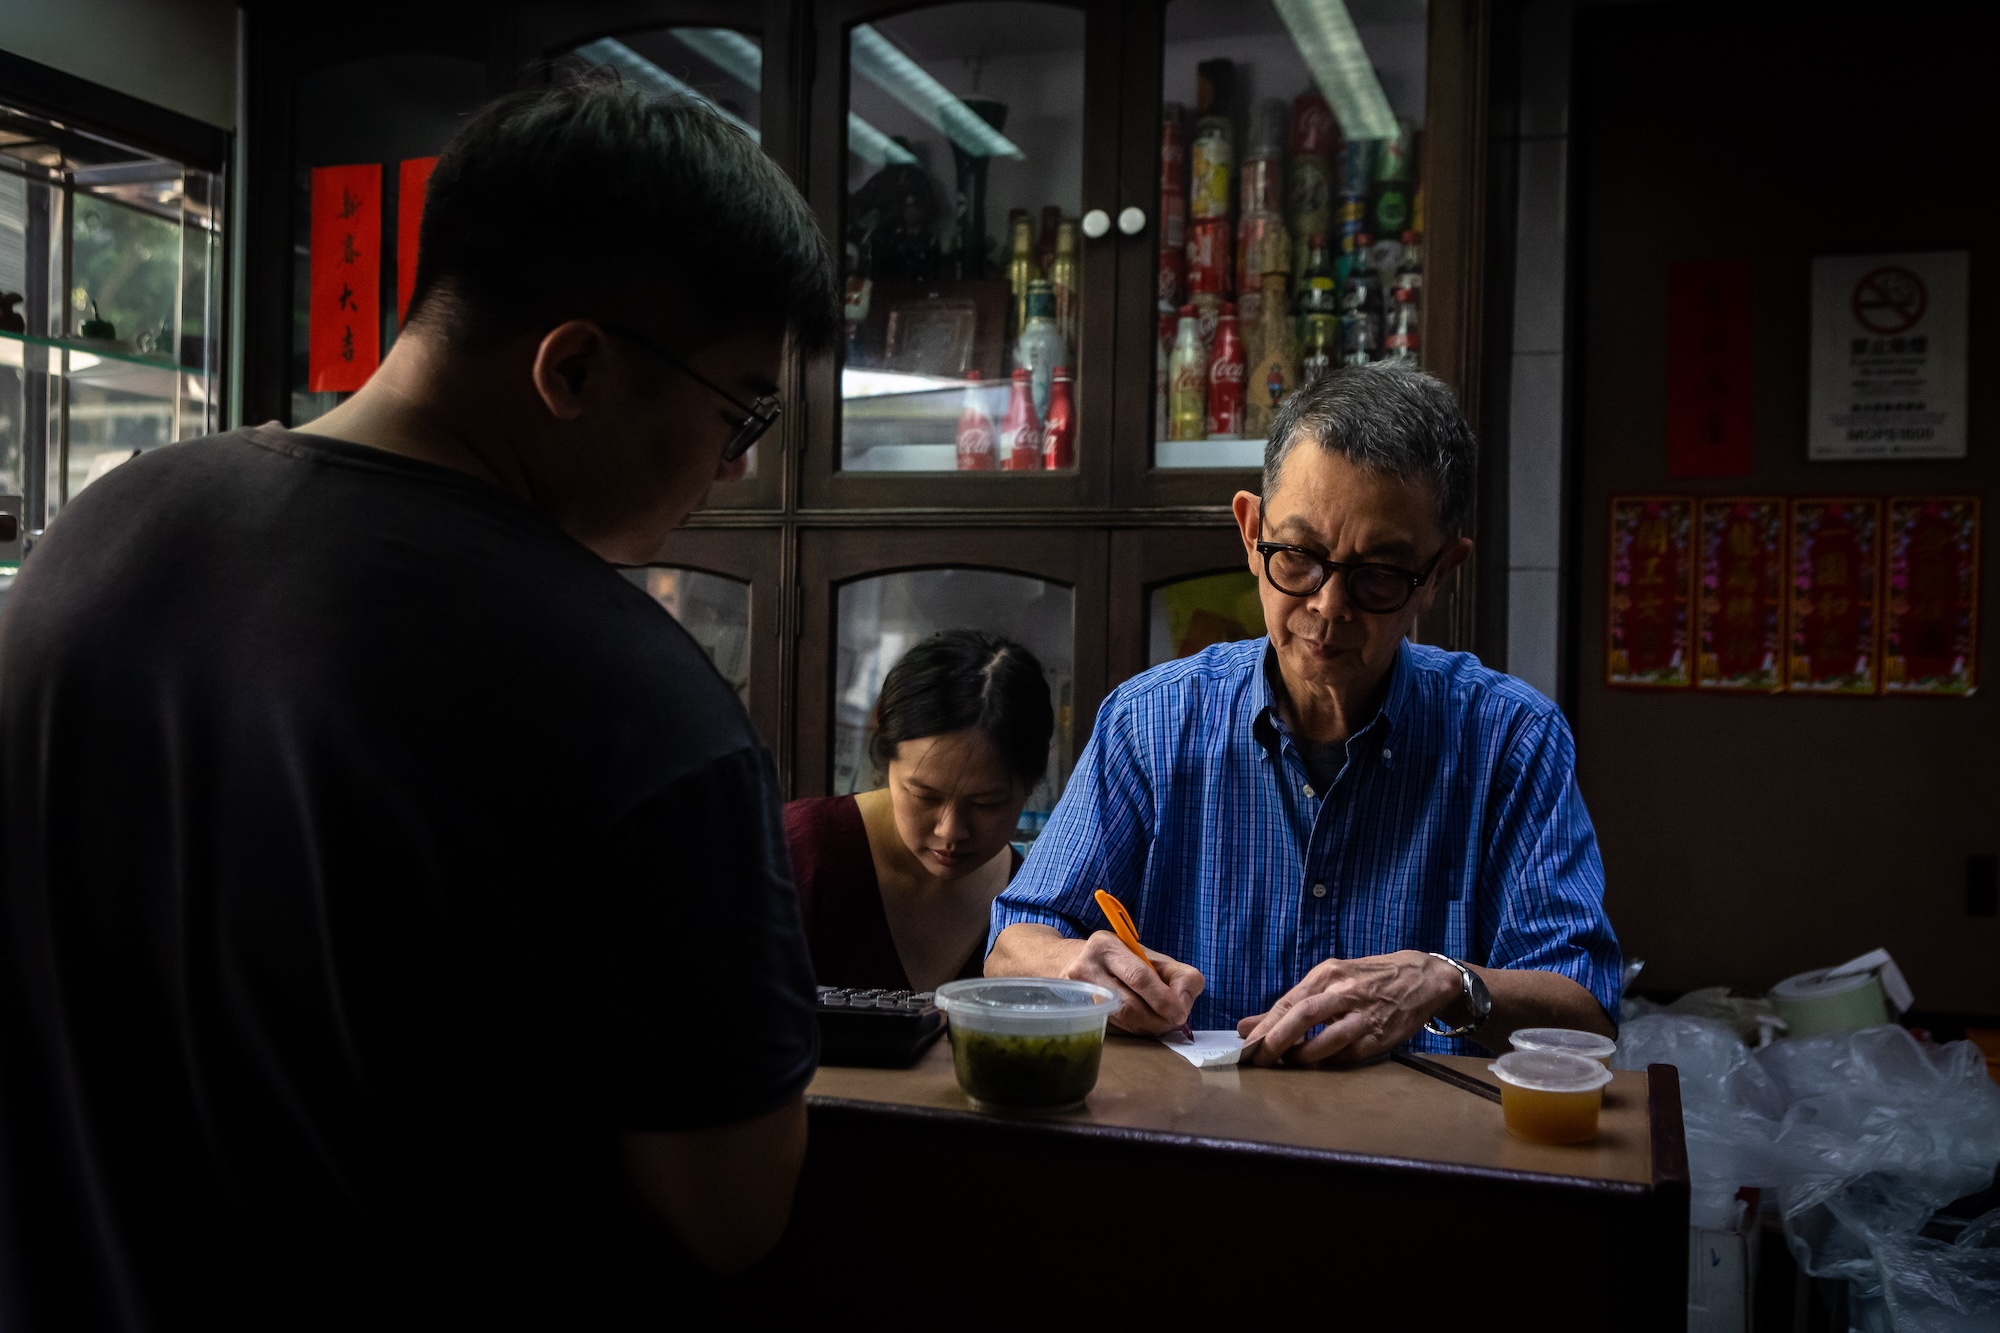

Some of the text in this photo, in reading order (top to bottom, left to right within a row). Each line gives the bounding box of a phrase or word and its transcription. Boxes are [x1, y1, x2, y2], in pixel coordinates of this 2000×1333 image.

[1210, 355, 1246, 384] Coca
[1635, 519, 1669, 661] 開工大
